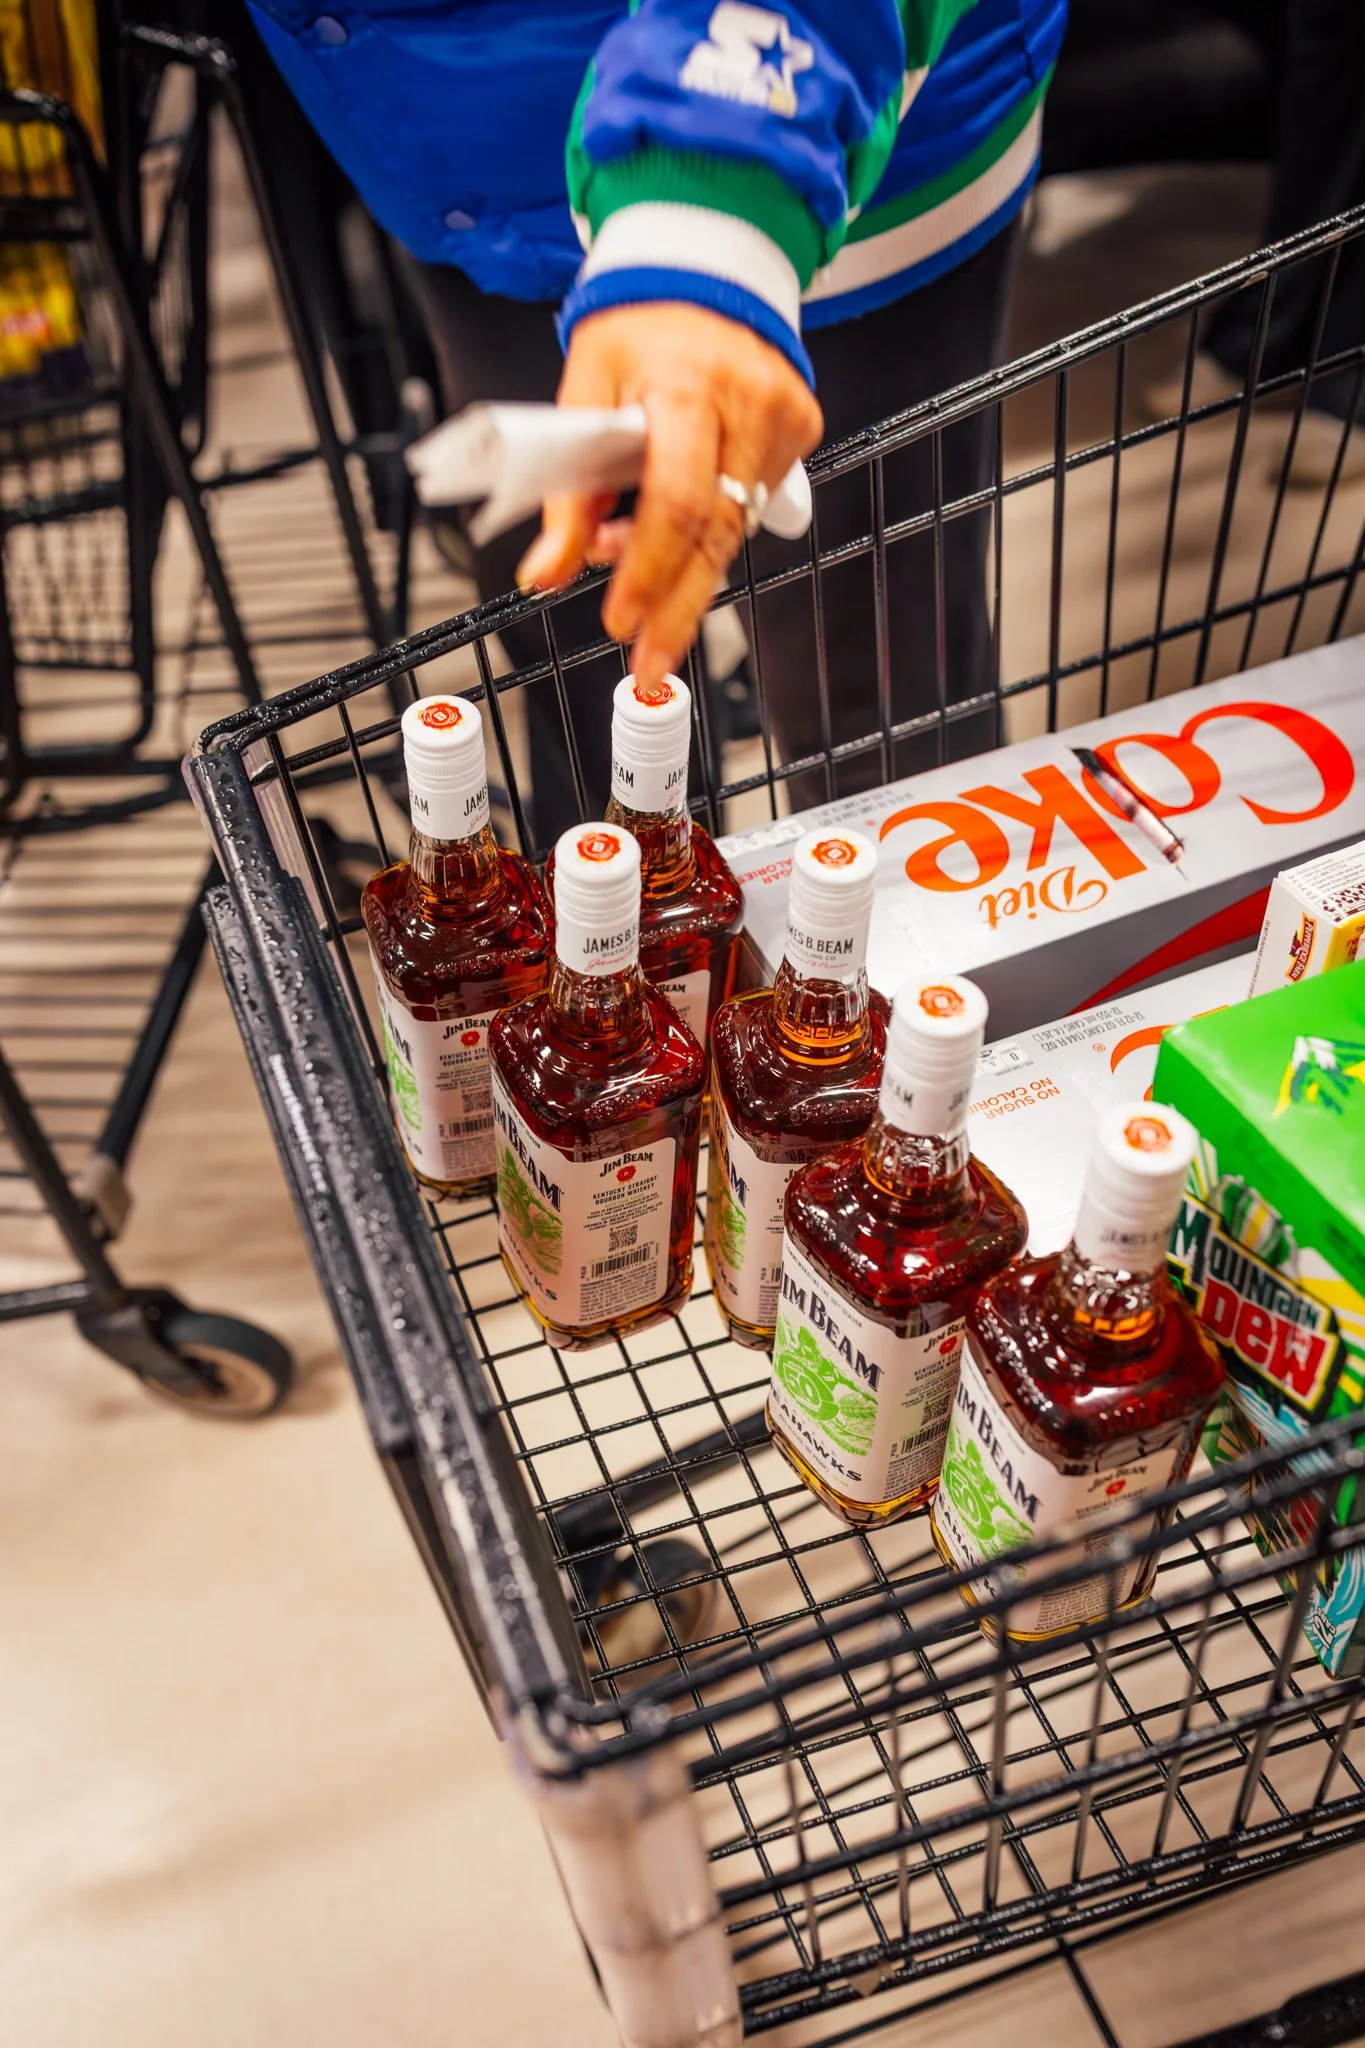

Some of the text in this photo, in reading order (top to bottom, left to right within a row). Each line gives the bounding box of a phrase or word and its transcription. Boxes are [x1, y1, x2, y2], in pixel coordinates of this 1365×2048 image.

[613, 757, 634, 788] EAM
[410, 789, 429, 816] EAM
[464, 782, 487, 816] JAME
[879, 702, 1355, 892] Coke
[738, 858, 793, 885] ALORIES
[763, 867, 793, 884] GAR
[979, 866, 1108, 931] Diet
[583, 932, 623, 954] JAMES
[817, 938, 853, 954] BEAM
[1291, 921, 1314, 978] PEPPERIDGE FARM
[443, 1023, 464, 1039] JIM
[1030, 1077, 1054, 1090] NO
[1037, 1086, 1061, 1100] NO
[967, 1086, 1028, 1116] CALORIE
[985, 1096, 1036, 1120] SUGAR
[508, 1112, 561, 1212] BEAM
[600, 1152, 653, 1177] JIM BEAM
[593, 1175, 658, 1199] KENTUCKY STRAIGHT
[595, 1194, 625, 1205] BOURBON
[627, 1183, 655, 1196] WHISKEY
[809, 1290, 881, 1392] BEAM
[947, 1322, 965, 1336] BEA
[782, 1360, 821, 1412] 50
[771, 1388, 862, 1481] EAHAWKS
[957, 1381, 977, 1428] IM
[977, 1407, 1039, 1522] BEAM
